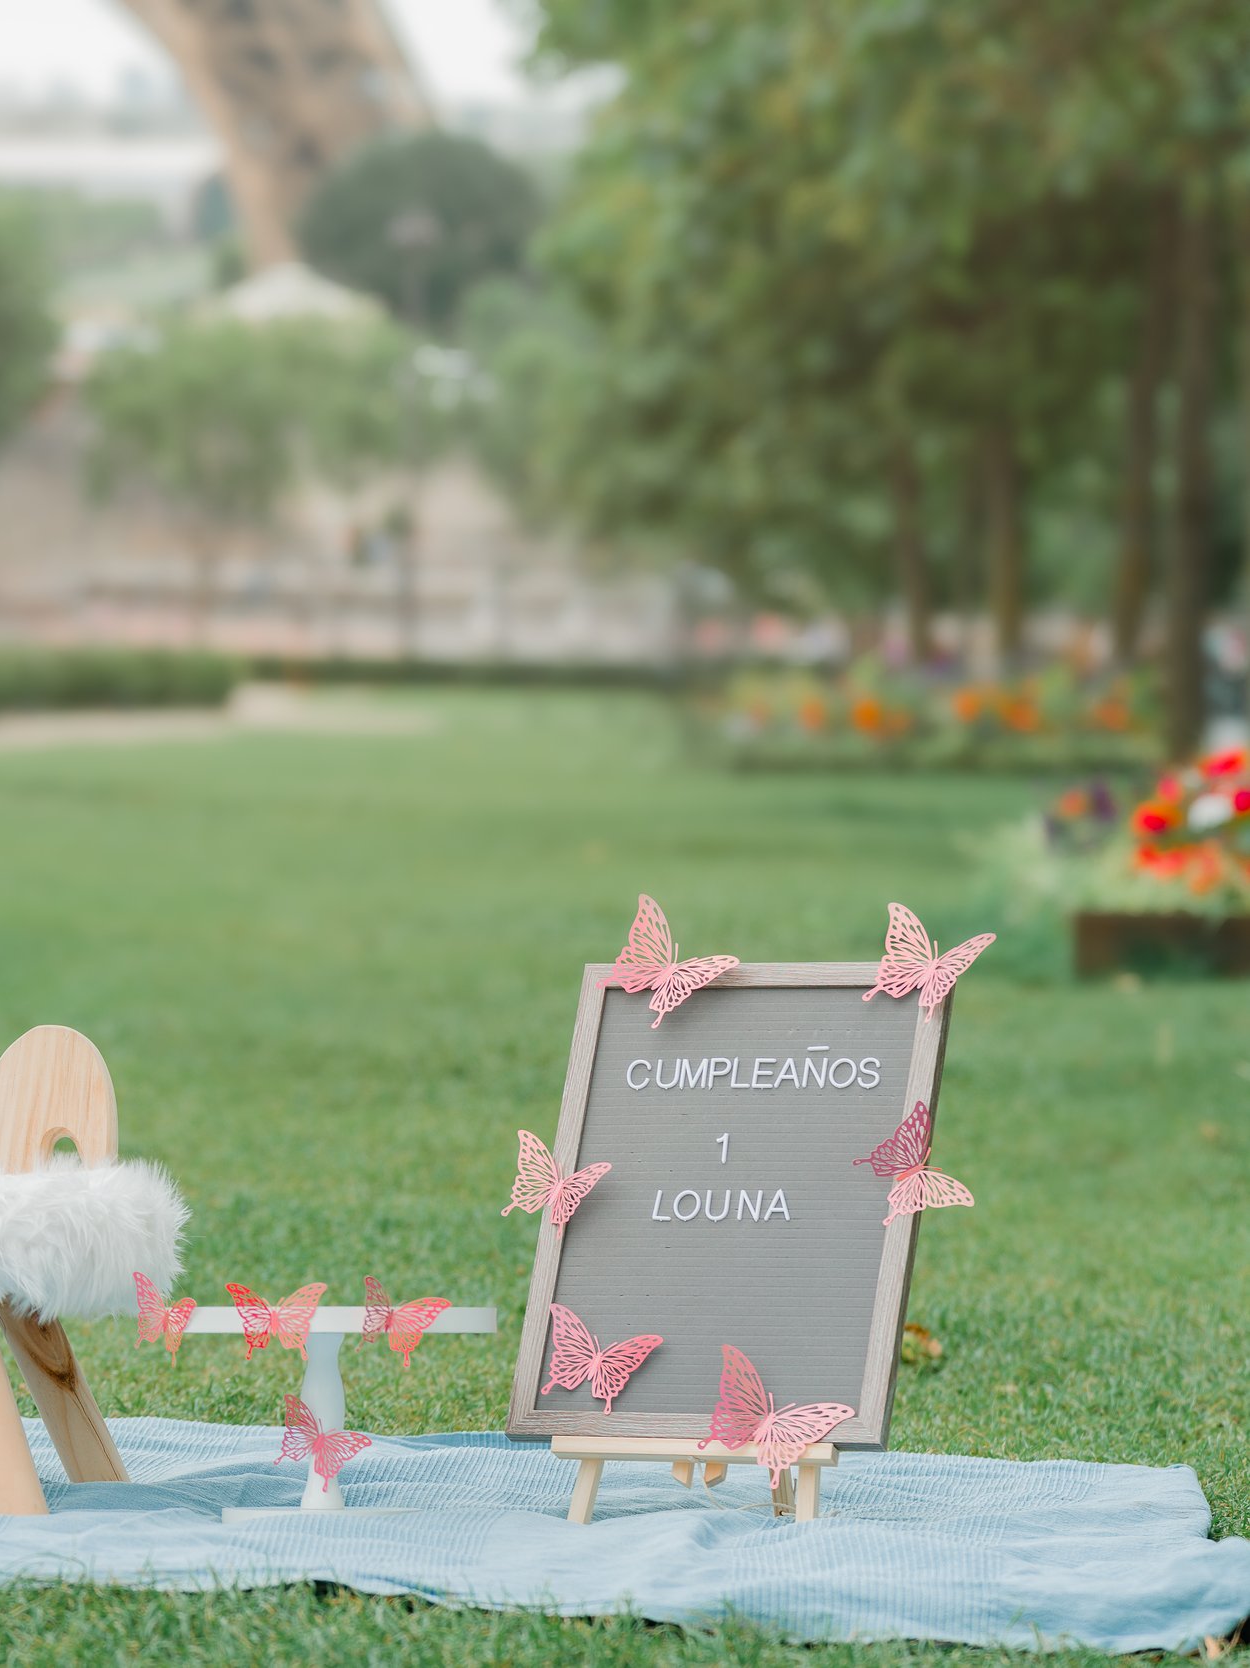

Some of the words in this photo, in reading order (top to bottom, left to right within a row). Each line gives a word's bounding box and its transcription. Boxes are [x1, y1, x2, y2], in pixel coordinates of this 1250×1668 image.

[626, 1045, 882, 1091] CUMPLEAÑOS
[715, 1132, 730, 1165] 1
[651, 1188, 791, 1223] LOUNA
